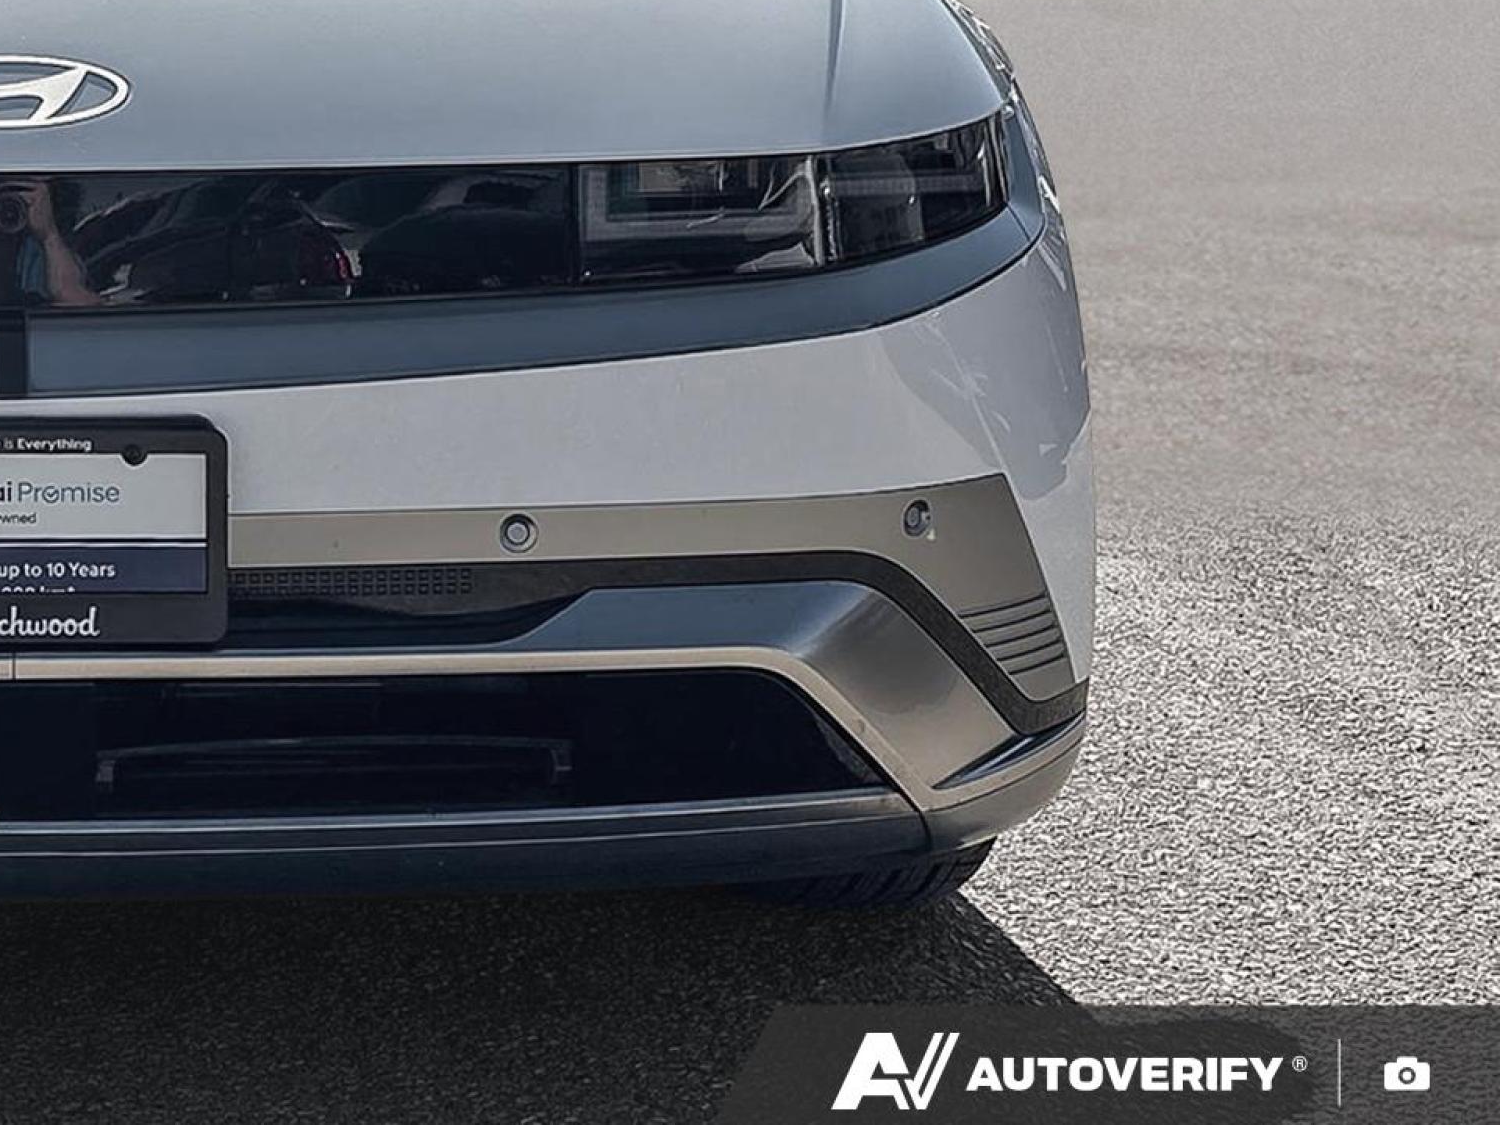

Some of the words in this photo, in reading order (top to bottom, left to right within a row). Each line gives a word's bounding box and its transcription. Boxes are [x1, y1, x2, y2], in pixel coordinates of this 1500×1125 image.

[4, 438, 13, 449] is
[17, 438, 92, 452] Everything
[17, 481, 120, 504] Promise
[24, 563, 42, 578] to
[46, 562, 65, 578] 10
[68, 561, 116, 578] Years
